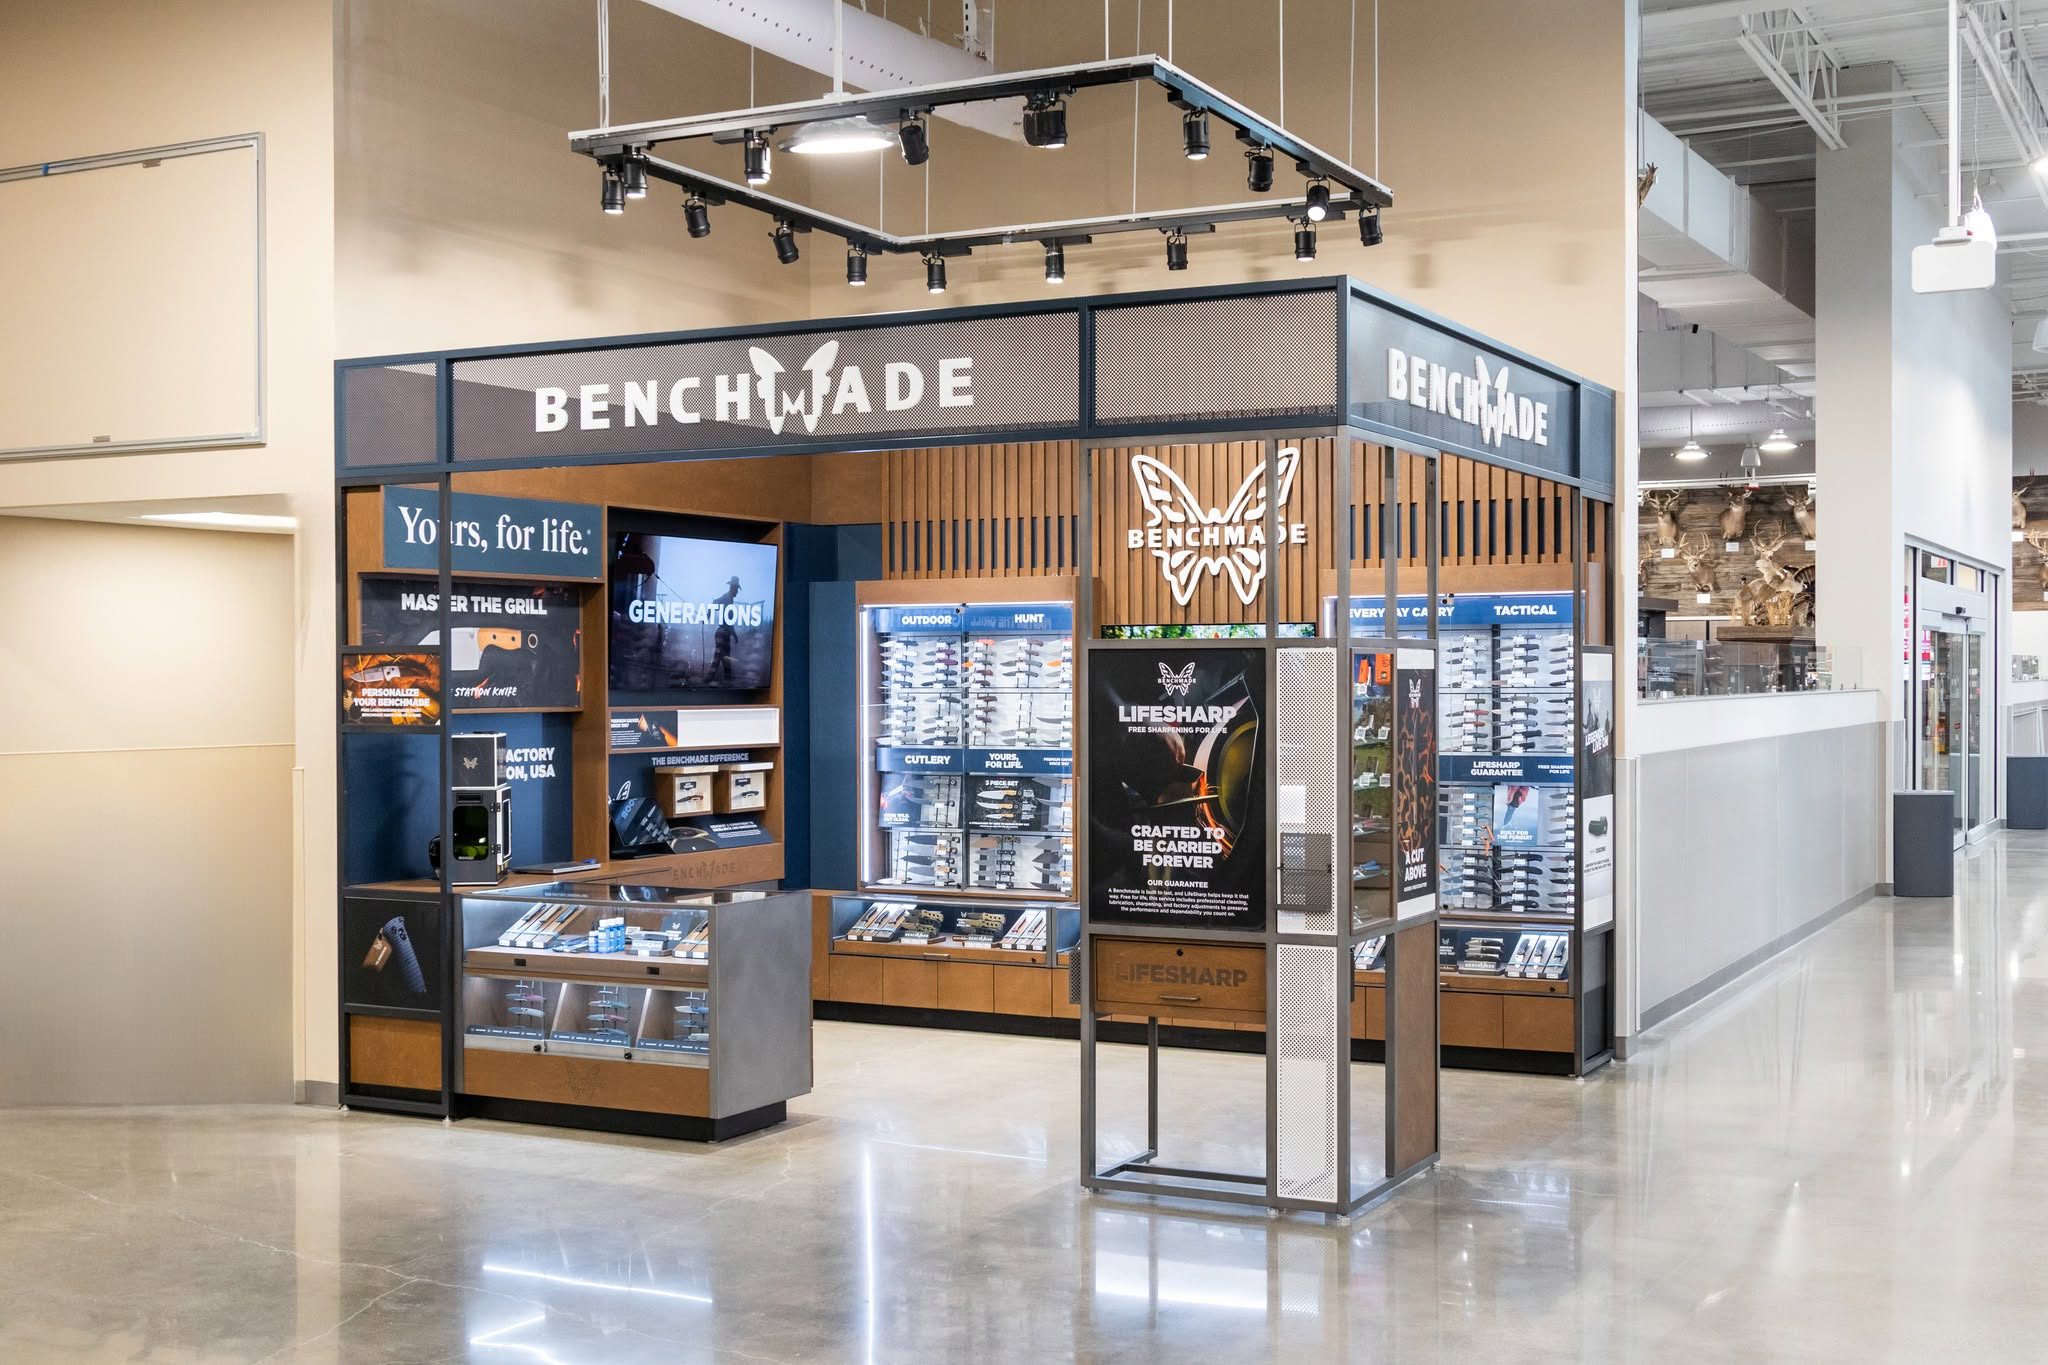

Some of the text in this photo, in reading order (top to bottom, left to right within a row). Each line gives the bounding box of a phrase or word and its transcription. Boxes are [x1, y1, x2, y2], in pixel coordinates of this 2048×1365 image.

[535, 340, 975, 435] BENCHMADE
[1388, 347, 1548, 448] BENCHMADE
[496, 514, 535, 550] for
[401, 593, 548, 616] MASER THE GRILL
[1412, 606, 1455, 617] CARY
[1494, 604, 1557, 616] TACTICAL
[629, 599, 762, 627] GENERATIONS
[901, 615, 953, 625] OUTDOOR
[1014, 613, 1045, 624] HUNT
[361, 687, 420, 697] PERSONALIZE
[454, 686, 518, 698] STATION KNIFE
[353, 697, 431, 707] YOUR BENCHMADE
[1118, 705, 1237, 723] LIFESHARP
[1147, 726, 1194, 734] SHARPENING
[506, 747, 556, 763] ACTORY
[651, 752, 749, 766] THE BENCHMADE DIFFERENCE
[904, 754, 951, 765] CUTLERY
[989, 753, 1020, 762] YOURS,
[530, 764, 556, 779] USA
[985, 760, 1024, 769] FOR LIFE.
[1473, 761, 1521, 769] LIFESHARP
[1470, 768, 1524, 777] GUARANTEE
[1131, 824, 1225, 840] CRAFTED TO
[1133, 839, 1223, 854] BE CARRIED
[1142, 854, 1214, 869] FOREVER
[1405, 847, 1425, 865] A CUT
[1404, 863, 1427, 882] ABOVE
[1147, 879, 1209, 889] OUR GUARANTEE
[1114, 961, 1249, 988] LIFESHARP
